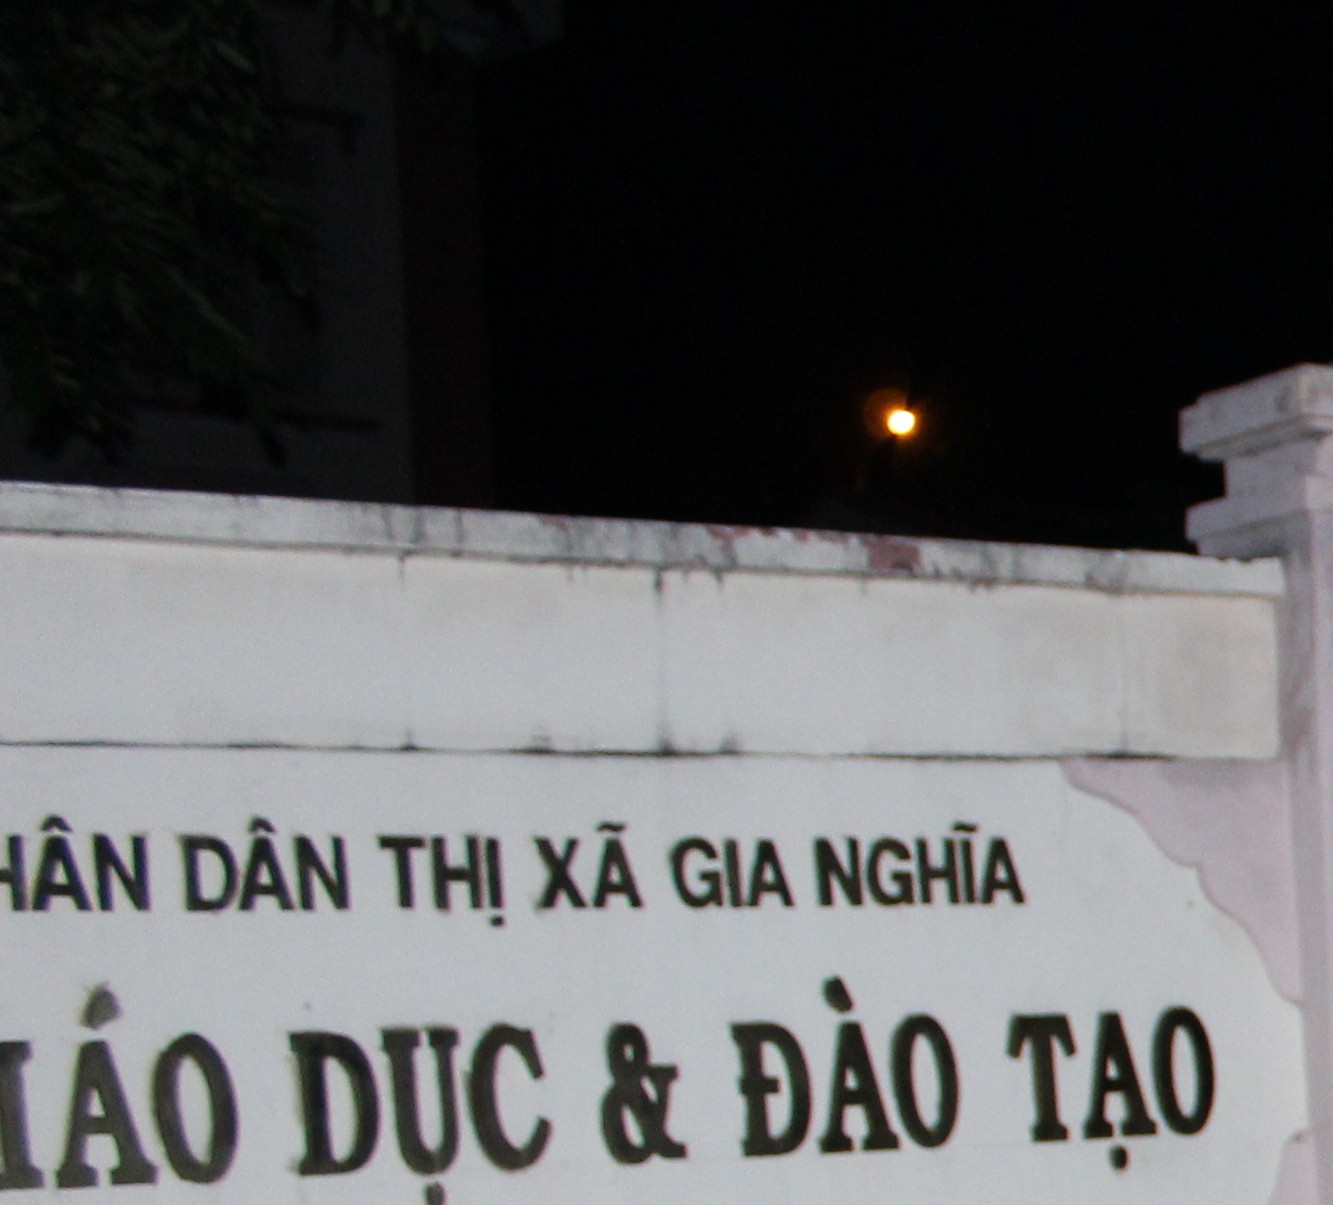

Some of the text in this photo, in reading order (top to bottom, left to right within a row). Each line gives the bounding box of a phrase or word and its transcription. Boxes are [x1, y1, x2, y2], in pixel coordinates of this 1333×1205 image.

[178, 815, 350, 913] DÂN
[377, 833, 506, 928] THỊ
[532, 820, 644, 912] XÃ
[668, 836, 796, 910] GIA
[813, 821, 1026, 909] NGHĨA
[599, 1021, 688, 1166] &
[730, 975, 960, 1158] ĐÀO
[1005, 1005, 1216, 1171] TẠO
